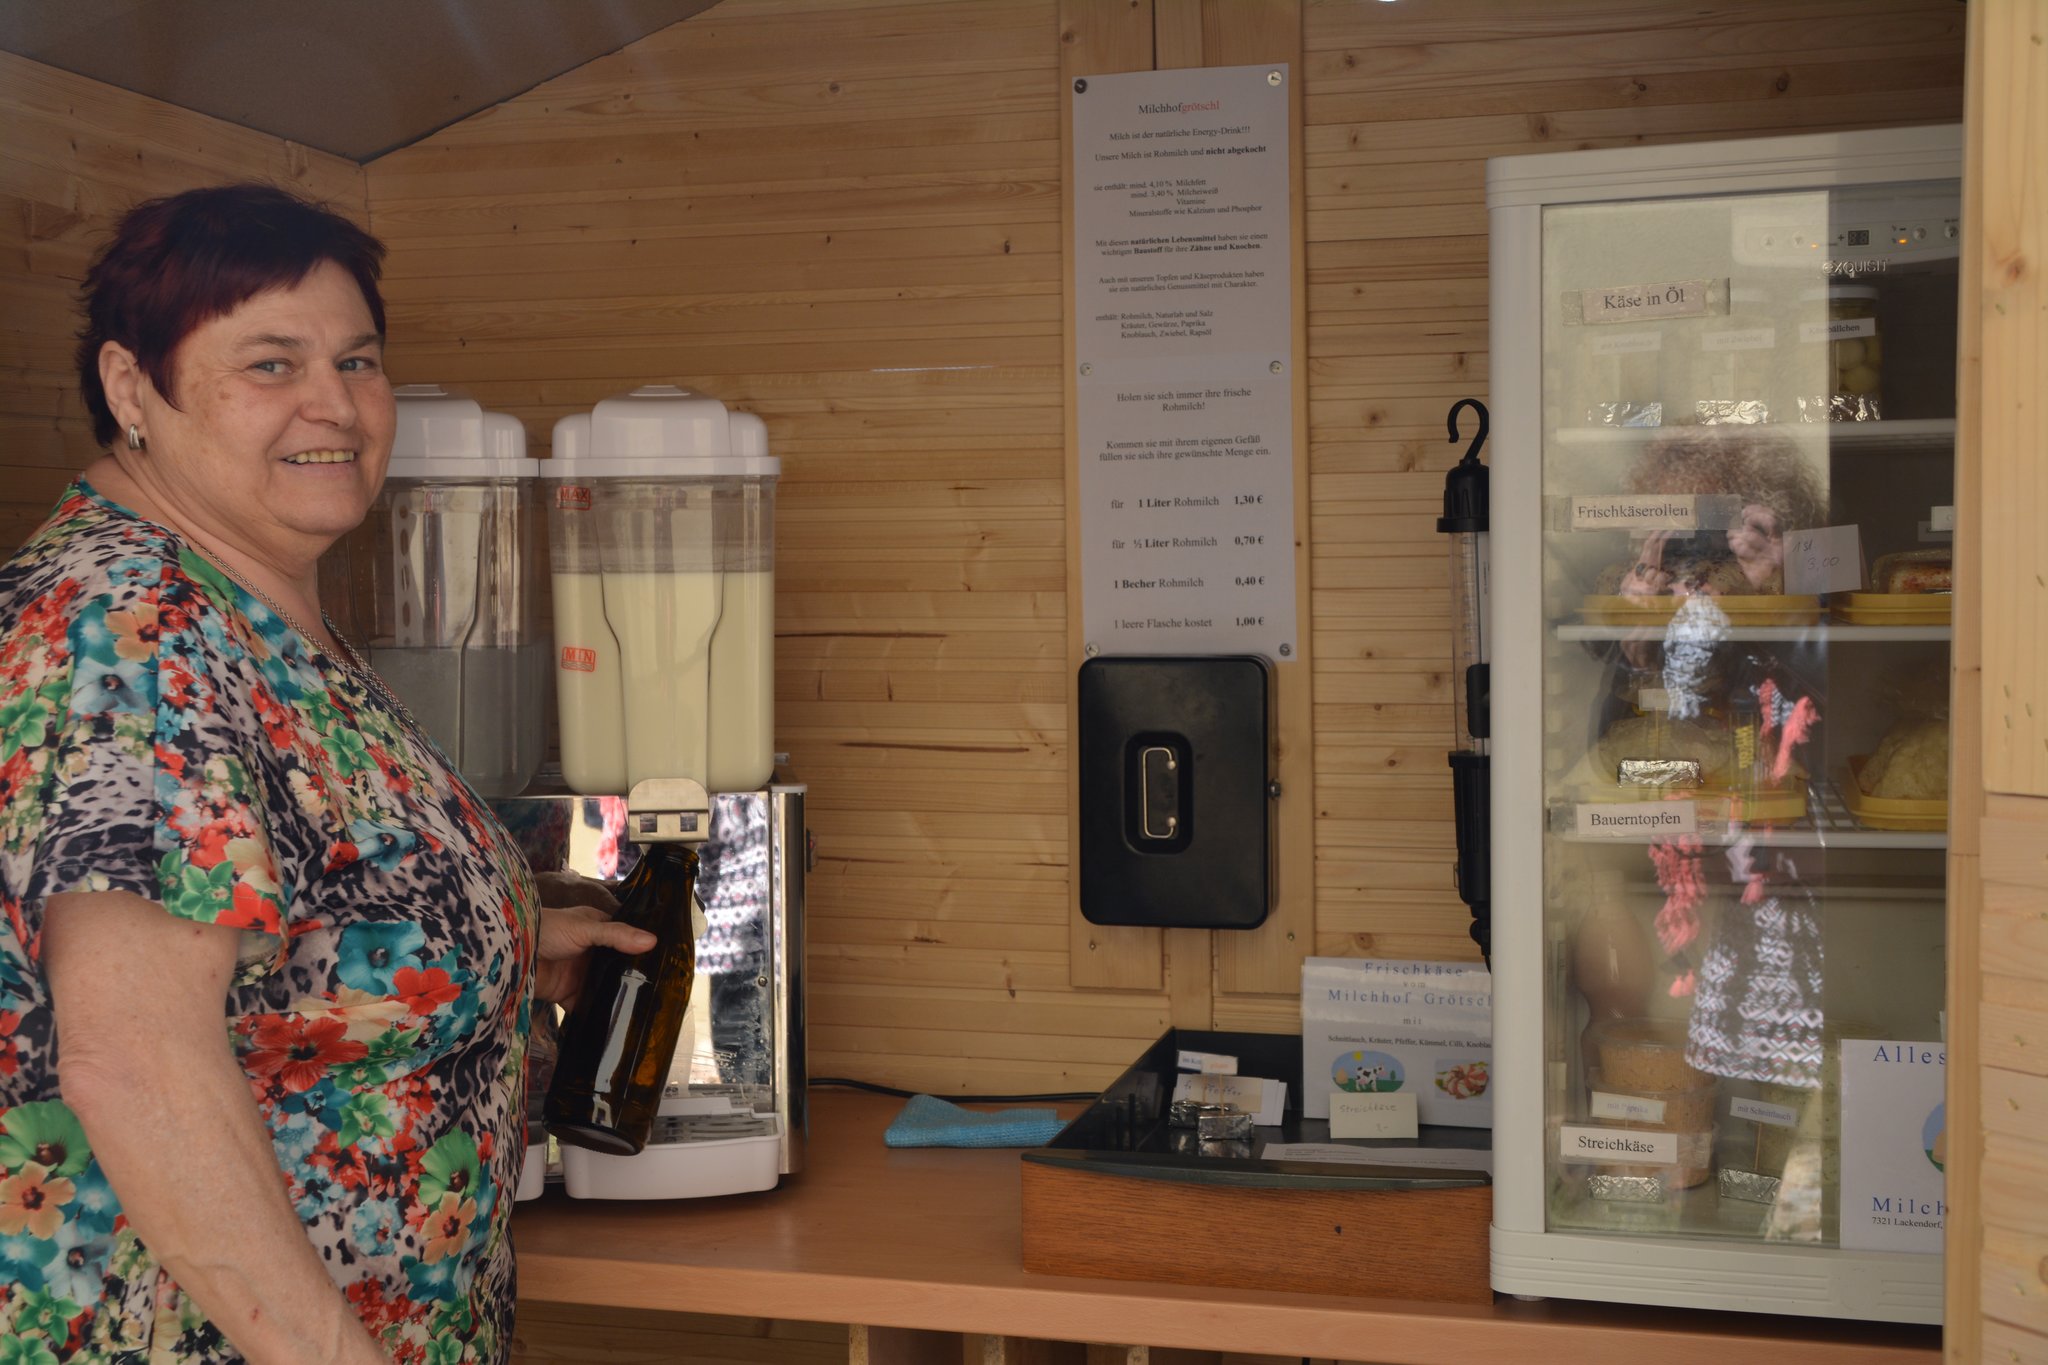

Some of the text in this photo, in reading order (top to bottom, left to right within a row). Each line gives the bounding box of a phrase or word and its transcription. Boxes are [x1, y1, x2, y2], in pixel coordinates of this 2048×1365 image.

[1138, 100, 1220, 115] Milchhofgrötschl
[1109, 130, 1130, 141] Milch
[1142, 129, 1153, 139] der
[1155, 128, 1191, 138] natürliche
[1193, 126, 1250, 137] Energy-Drink!!!
[1095, 145, 1266, 161] Unsere Milch ist Rohmilch und nicht abgekocht
[1175, 179, 1206, 187] Milchfett
[1176, 197, 1205, 205] Vitamine
[1129, 208, 1172, 217] Mineralstoffe
[1187, 206, 1215, 215] Kalzium
[1231, 205, 1262, 214] Phosphor
[1131, 237, 1169, 245] natürlichen
[1171, 235, 1216, 243] Lebensmittel
[1218, 234, 1238, 242] haben
[1190, 244, 1212, 252] Zähne
[1156, 274, 1178, 283] Topfen
[1180, 273, 1192, 281] und
[1194, 272, 1243, 281] Käseprodukten
[1224, 280, 1258, 288] Charakter.
[1604, 286, 1685, 310] Käse in Öl
[1121, 312, 1154, 320] Rohmilch,
[1181, 320, 1205, 328] Paprika
[1117, 393, 1142, 402] Holen
[1157, 392, 1174, 400] sich
[1176, 391, 1202, 399] immer
[1205, 390, 1221, 398] ihre
[1223, 389, 1251, 397] frische
[1162, 402, 1205, 412] Rohmilch!
[1106, 435, 1260, 450] Kommen sie mit ihrem eigenen Gefäß
[1099, 451, 1122, 461] füllen
[1124, 452, 1137, 460] sie
[1139, 450, 1154, 459] sich
[1157, 450, 1173, 458] ihre
[1175, 448, 1222, 460] gewünschte
[1225, 448, 1253, 457] Menge
[560, 486, 589, 501] MAX
[1111, 500, 1124, 509] für
[1147, 498, 1171, 508] Liter
[1174, 496, 1220, 506] Rohmilch
[1234, 495, 1254, 505] 1,30
[1577, 503, 1688, 518] Frischkäserollen
[1112, 540, 1125, 549] für
[1145, 539, 1170, 548] Liter
[1172, 537, 1218, 547] Rohmilch
[1235, 536, 1255, 546] 0,70
[1122, 579, 1156, 588] Becher
[1159, 578, 1204, 587] Rohmilch
[1235, 576, 1256, 586] 0,40
[1122, 620, 1144, 628] leere
[1147, 619, 1182, 628] Flasche
[1185, 618, 1212, 627] kostet
[1235, 617, 1255, 627] 1,00
[565, 647, 593, 662] MIN
[1591, 812, 1681, 828] Bauerntopfen
[1365, 961, 1464, 977] Frischkäse
[1328, 989, 1412, 1004] Milchhof
[1403, 1016, 1422, 1025] mit
[1873, 1044, 1945, 1066] Alles
[1737, 1104, 1749, 1112] mit
[1578, 1135, 1655, 1154] Streichkäse
[1872, 1216, 1944, 1231] 7321 Lackendorf,
